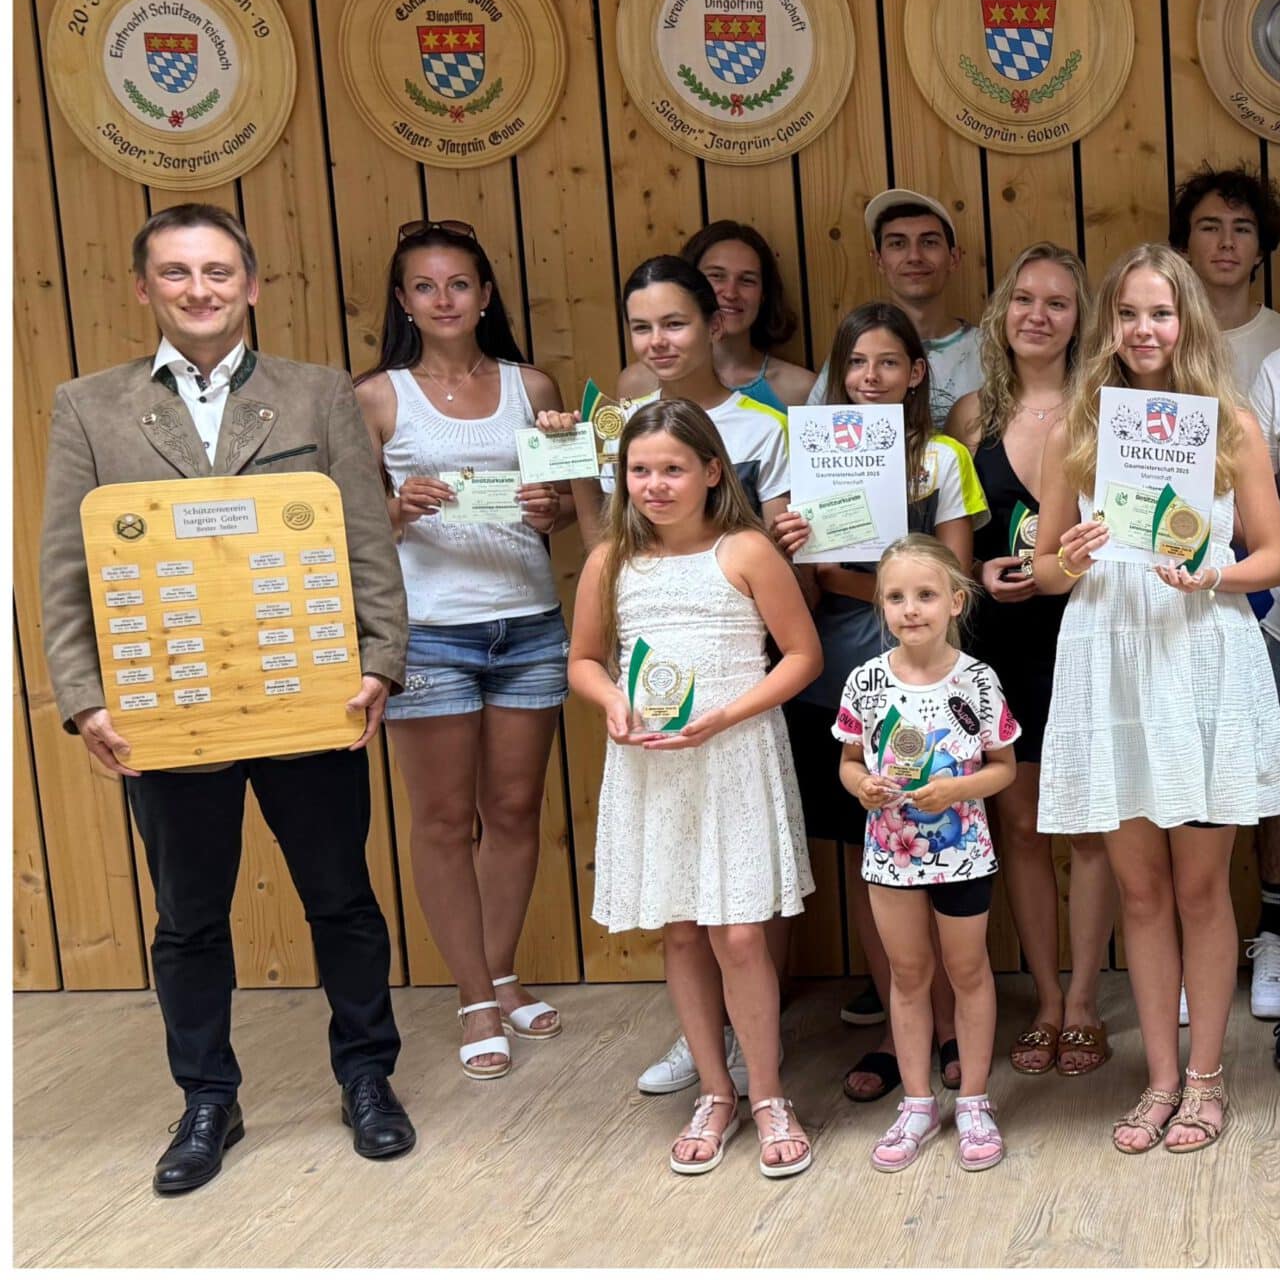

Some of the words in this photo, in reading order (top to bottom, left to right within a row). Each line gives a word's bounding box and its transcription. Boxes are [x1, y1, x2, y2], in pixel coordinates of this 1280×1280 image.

[68, 9, 89, 37] 20
[252, 19, 270, 38] 19
[110, 7, 149, 59] Eintracht
[149, 2, 201, 26] Schützen
[1230, 91, 1266, 125] Sieger
[811, 455, 885, 469] URKUNDE
[1120, 445, 1196, 464] URKUNDE
